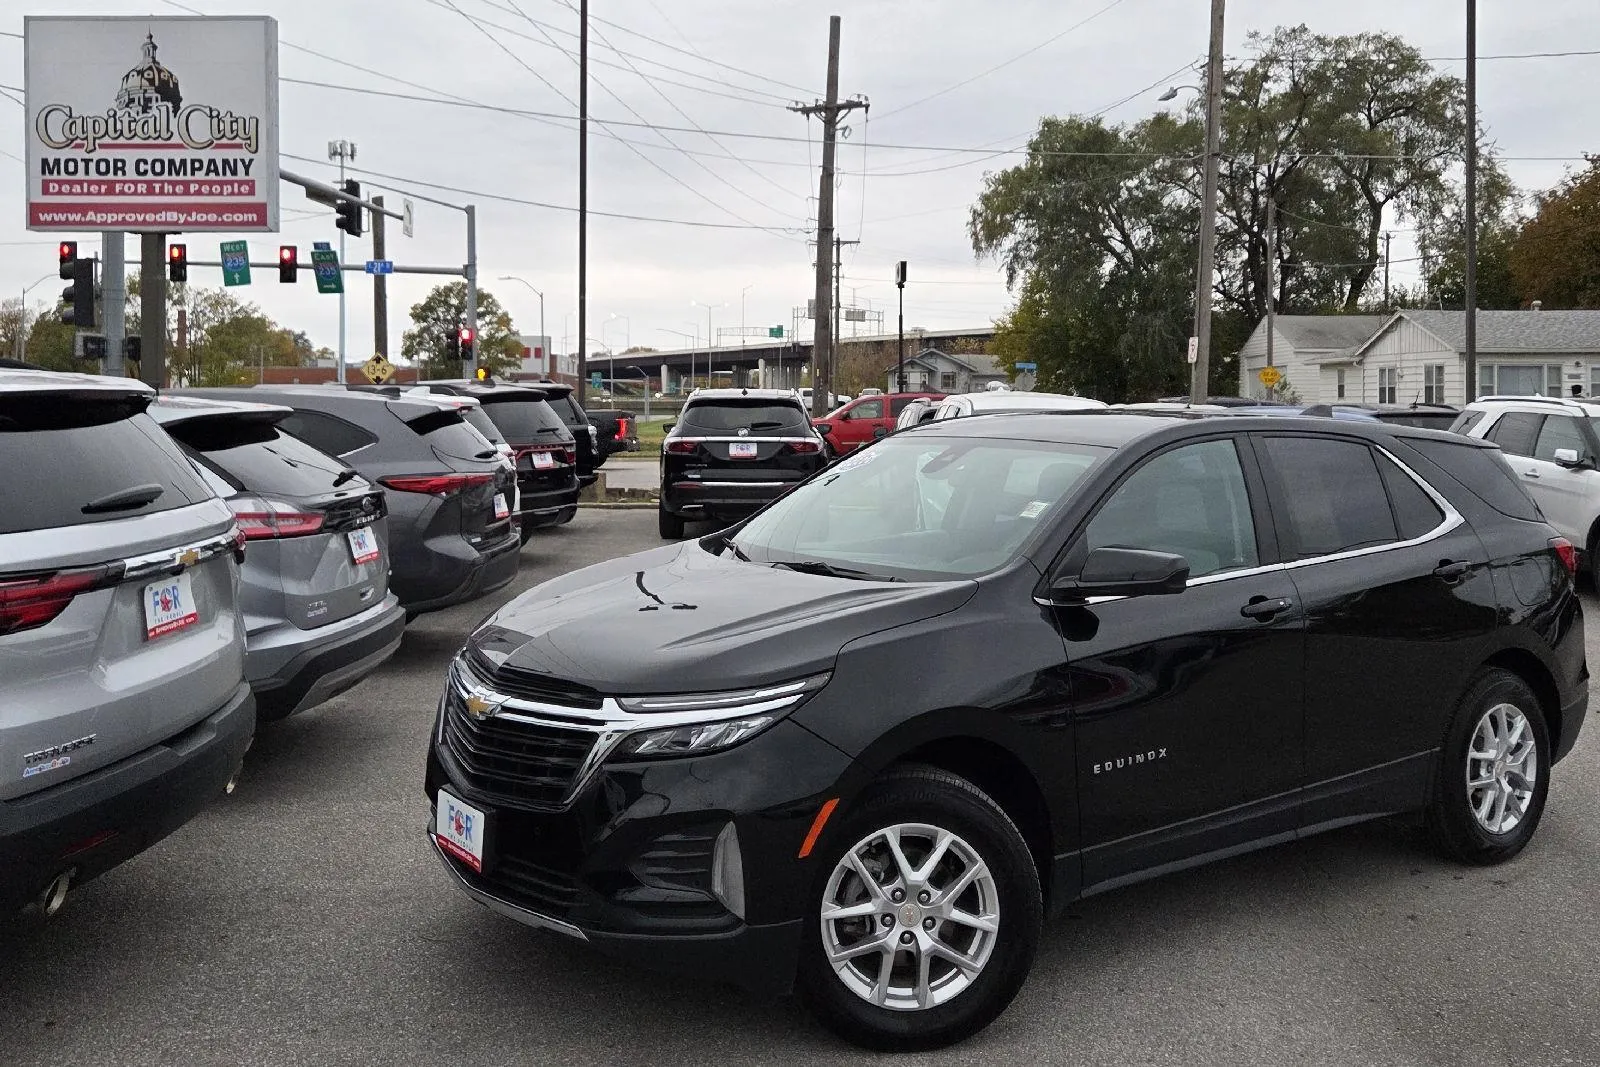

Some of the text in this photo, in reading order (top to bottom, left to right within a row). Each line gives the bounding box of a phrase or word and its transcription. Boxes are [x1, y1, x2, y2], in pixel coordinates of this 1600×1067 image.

[36, 104, 258, 153] Capital City
[40, 158, 254, 177] MOTOR COMPANY
[49, 182, 250, 195] Dealer FOR The People
[38, 211, 258, 224] www.ApprovedByJoe.com
[226, 257, 245, 267] 235
[367, 364, 387, 375] 13-6
[1093, 747, 1167, 774] EQUINOX
